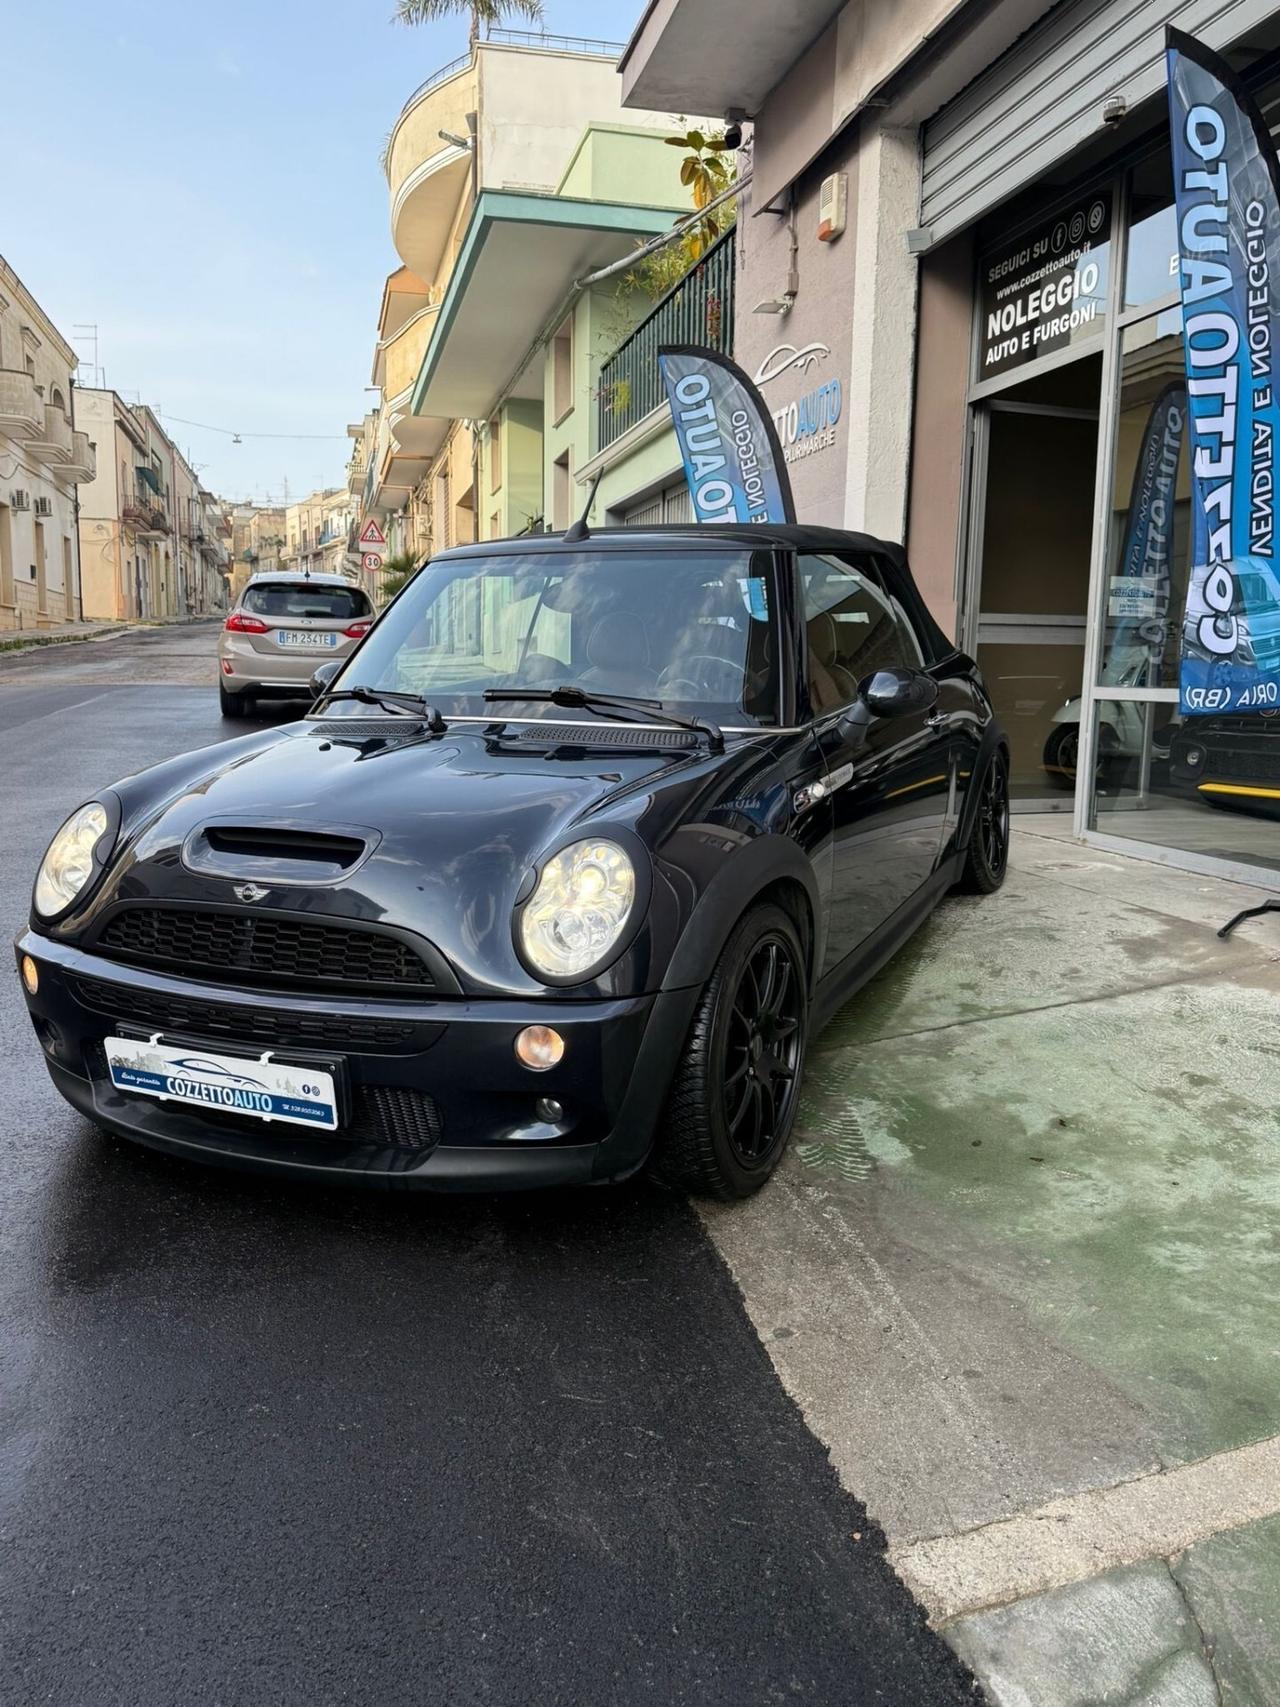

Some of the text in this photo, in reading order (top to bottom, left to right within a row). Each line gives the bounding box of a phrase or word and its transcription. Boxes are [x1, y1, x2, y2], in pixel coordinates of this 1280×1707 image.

[988, 237, 1048, 282] SEGUICI SU
[997, 241, 1091, 300] www.cozzettoauto.it
[987, 263, 1098, 340] NOLEGGIO
[985, 302, 1096, 366] AUTO E FURGONI
[367, 557, 378, 567] 30
[166, 1077, 272, 1112] COZZETTOAUTO
